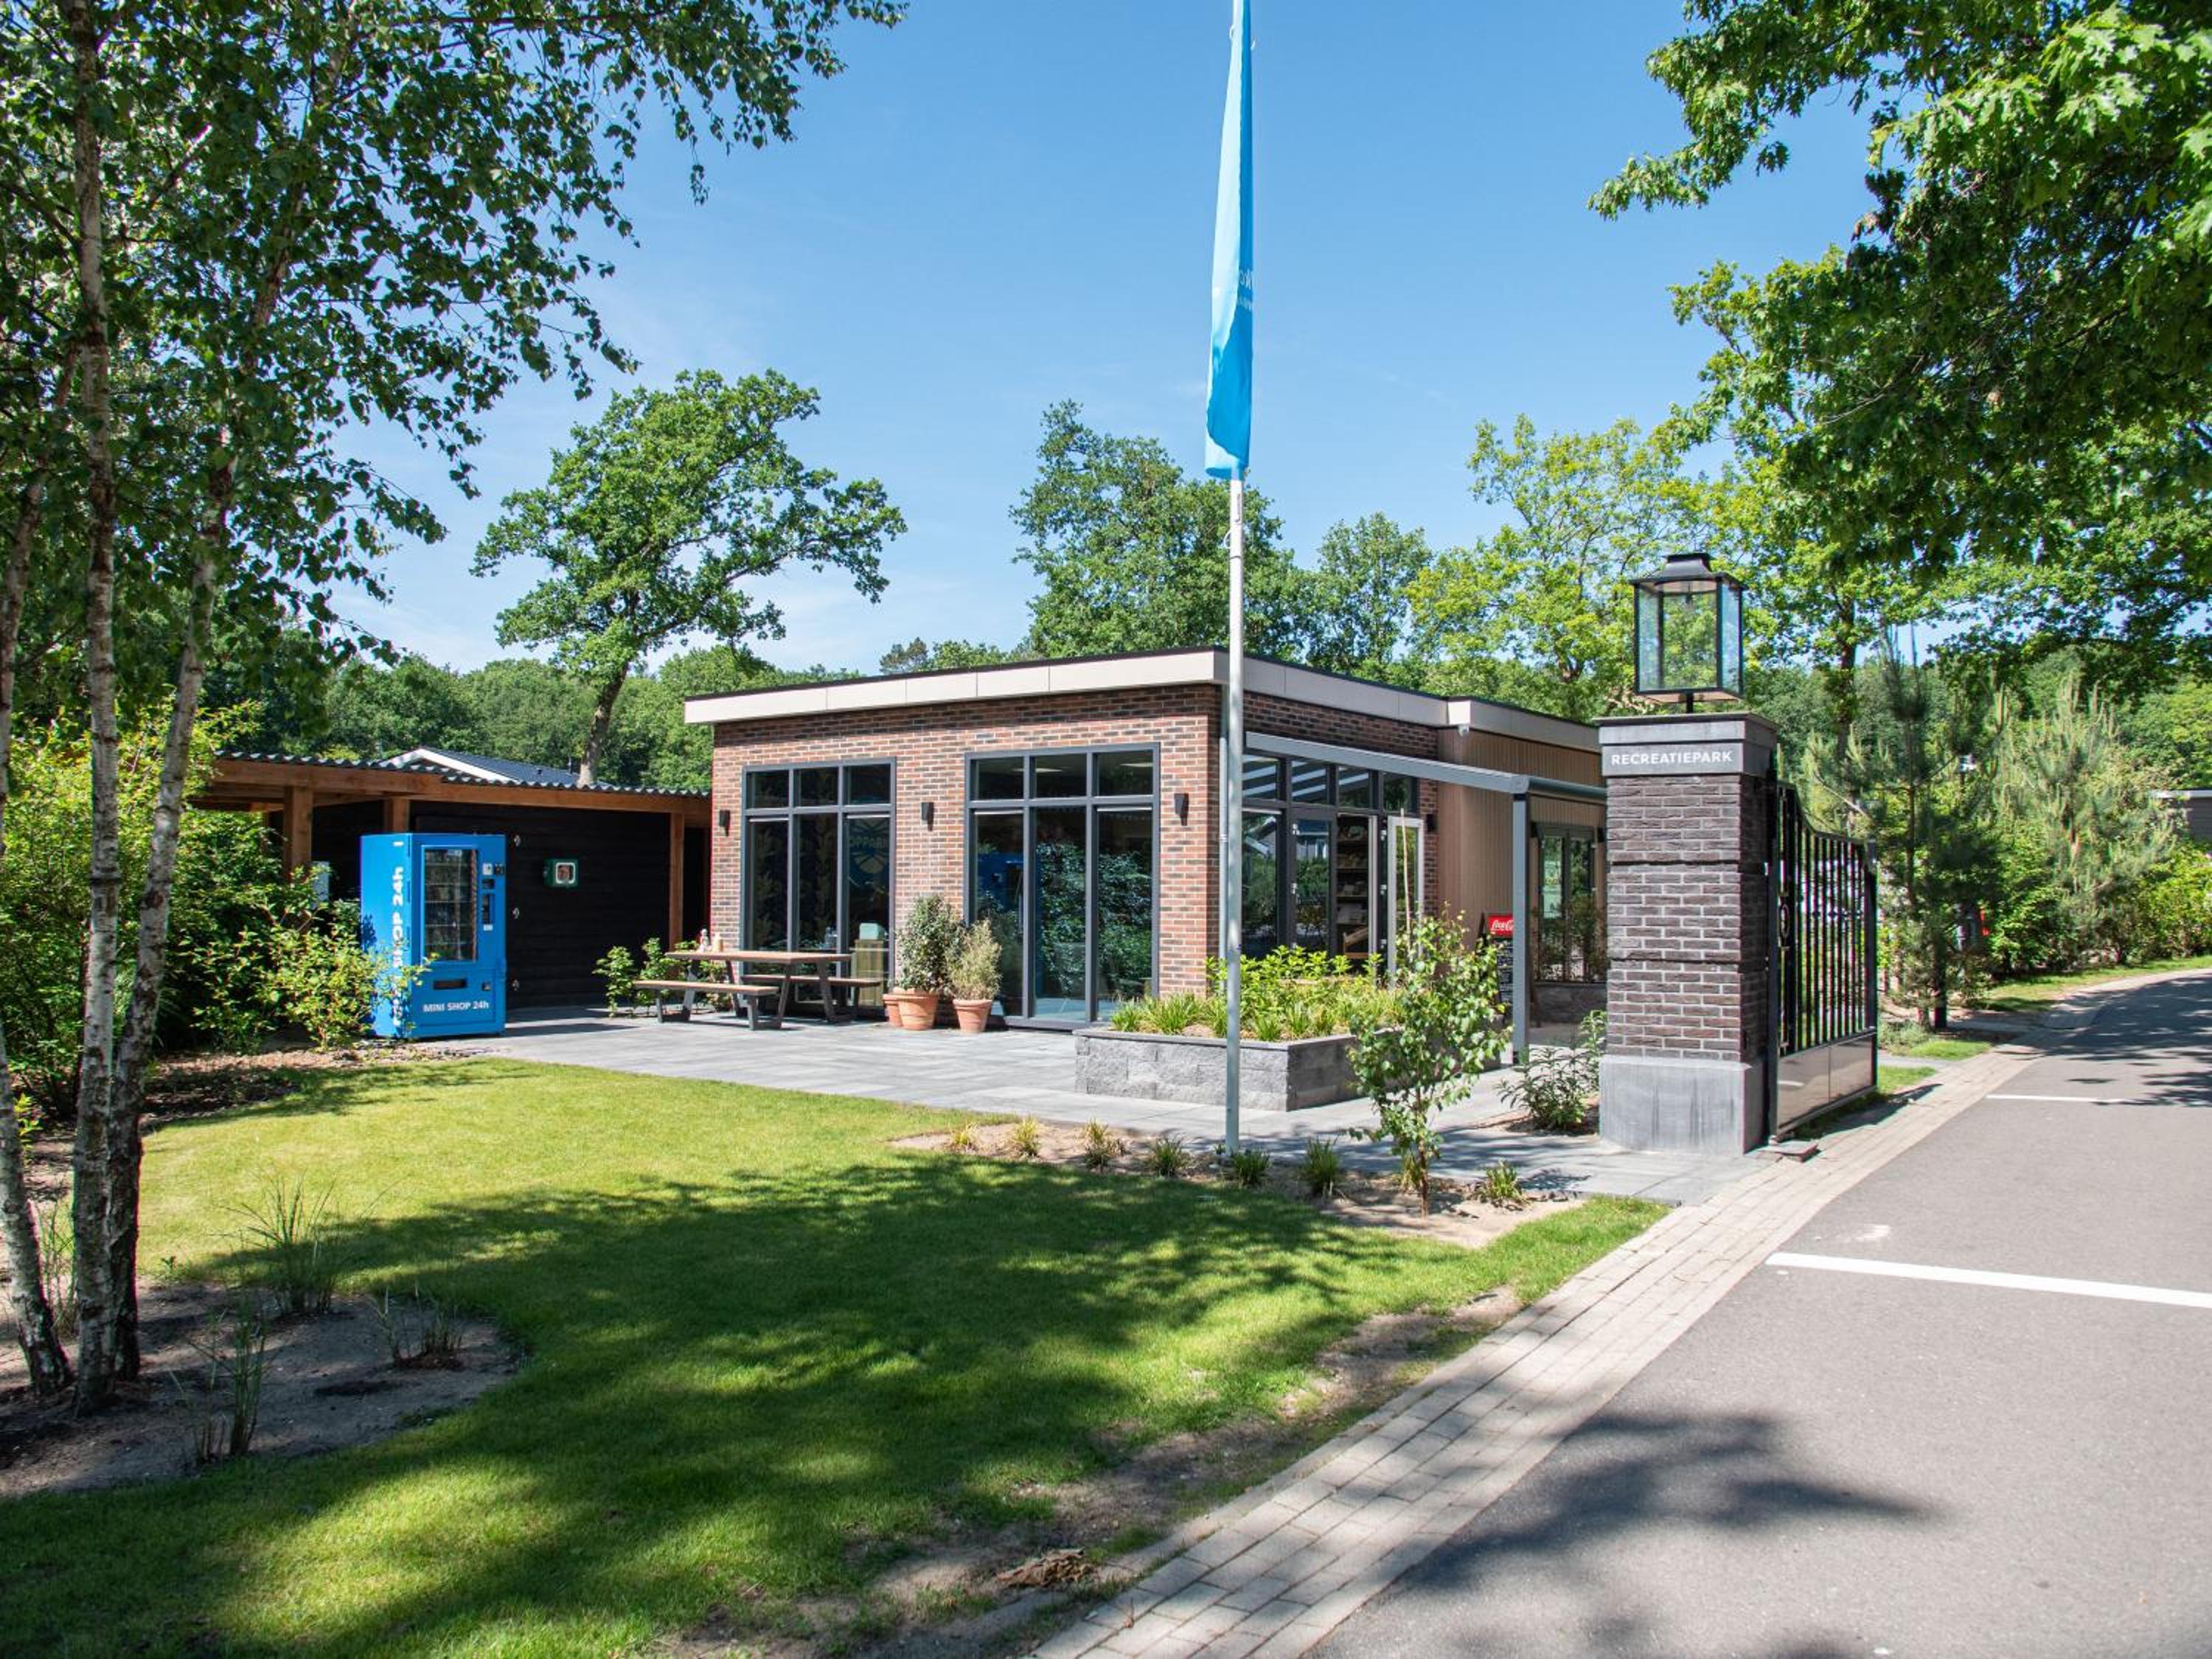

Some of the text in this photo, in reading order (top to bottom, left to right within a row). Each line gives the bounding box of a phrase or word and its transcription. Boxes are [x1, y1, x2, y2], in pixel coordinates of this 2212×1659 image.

[1611, 751, 1733, 765] RECREATIEPARK
[392, 866, 403, 906] 24h
[423, 1000, 490, 1012] MINI SHOP 24h
